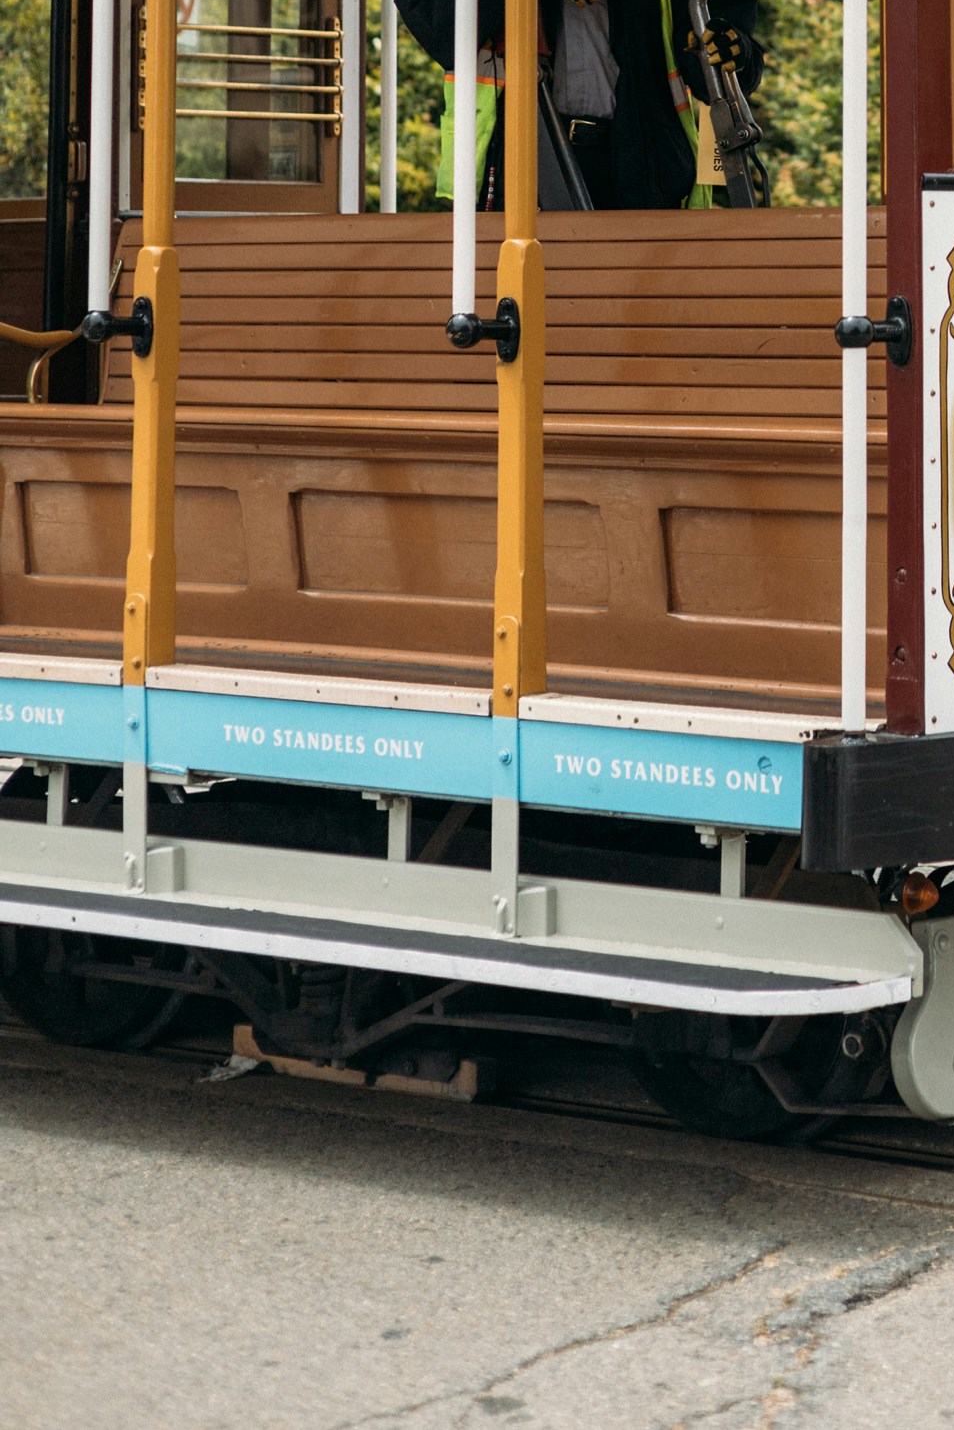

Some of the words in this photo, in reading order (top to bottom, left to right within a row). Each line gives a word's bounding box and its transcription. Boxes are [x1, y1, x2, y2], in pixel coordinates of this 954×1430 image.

[21, 705, 64, 725] ONLY
[223, 723, 266, 745] TWO
[273, 728, 366, 755] STANDEES
[373, 737, 424, 760] ONLY
[554, 753, 602, 777] TWO
[610, 758, 716, 788] STANDEES
[725, 769, 783, 795] ONLY
